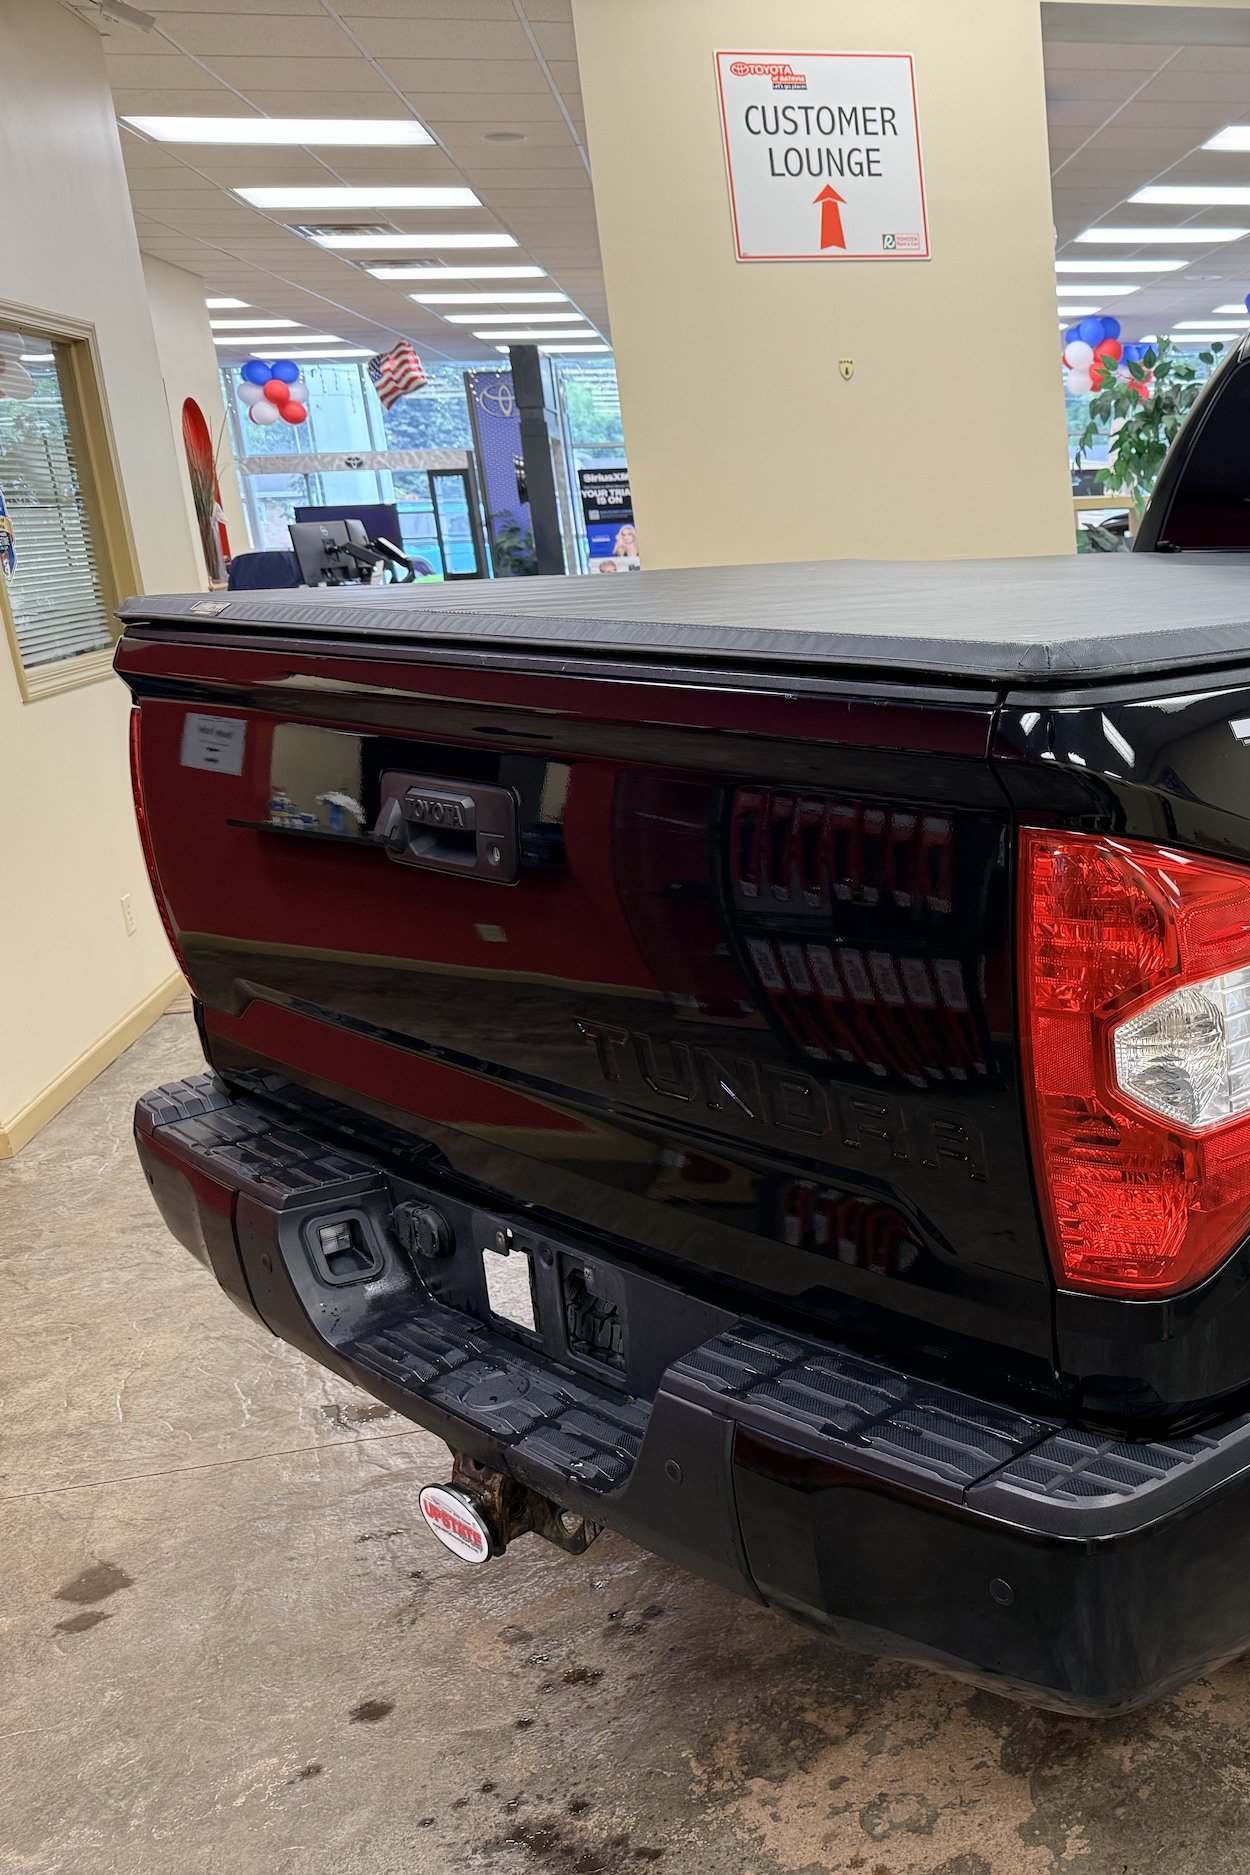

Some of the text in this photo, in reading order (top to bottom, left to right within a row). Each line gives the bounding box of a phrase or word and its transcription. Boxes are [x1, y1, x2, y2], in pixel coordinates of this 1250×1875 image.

[748, 65, 793, 76] TOYOTA
[745, 105, 898, 136] CUSTOMER
[768, 147, 883, 177] LOUNGE
[581, 488, 631, 498] YOUR TRIA
[597, 496, 623, 505] IS ON
[405, 797, 464, 827] TOYOTA
[572, 1016, 990, 1184] TUNDRA
